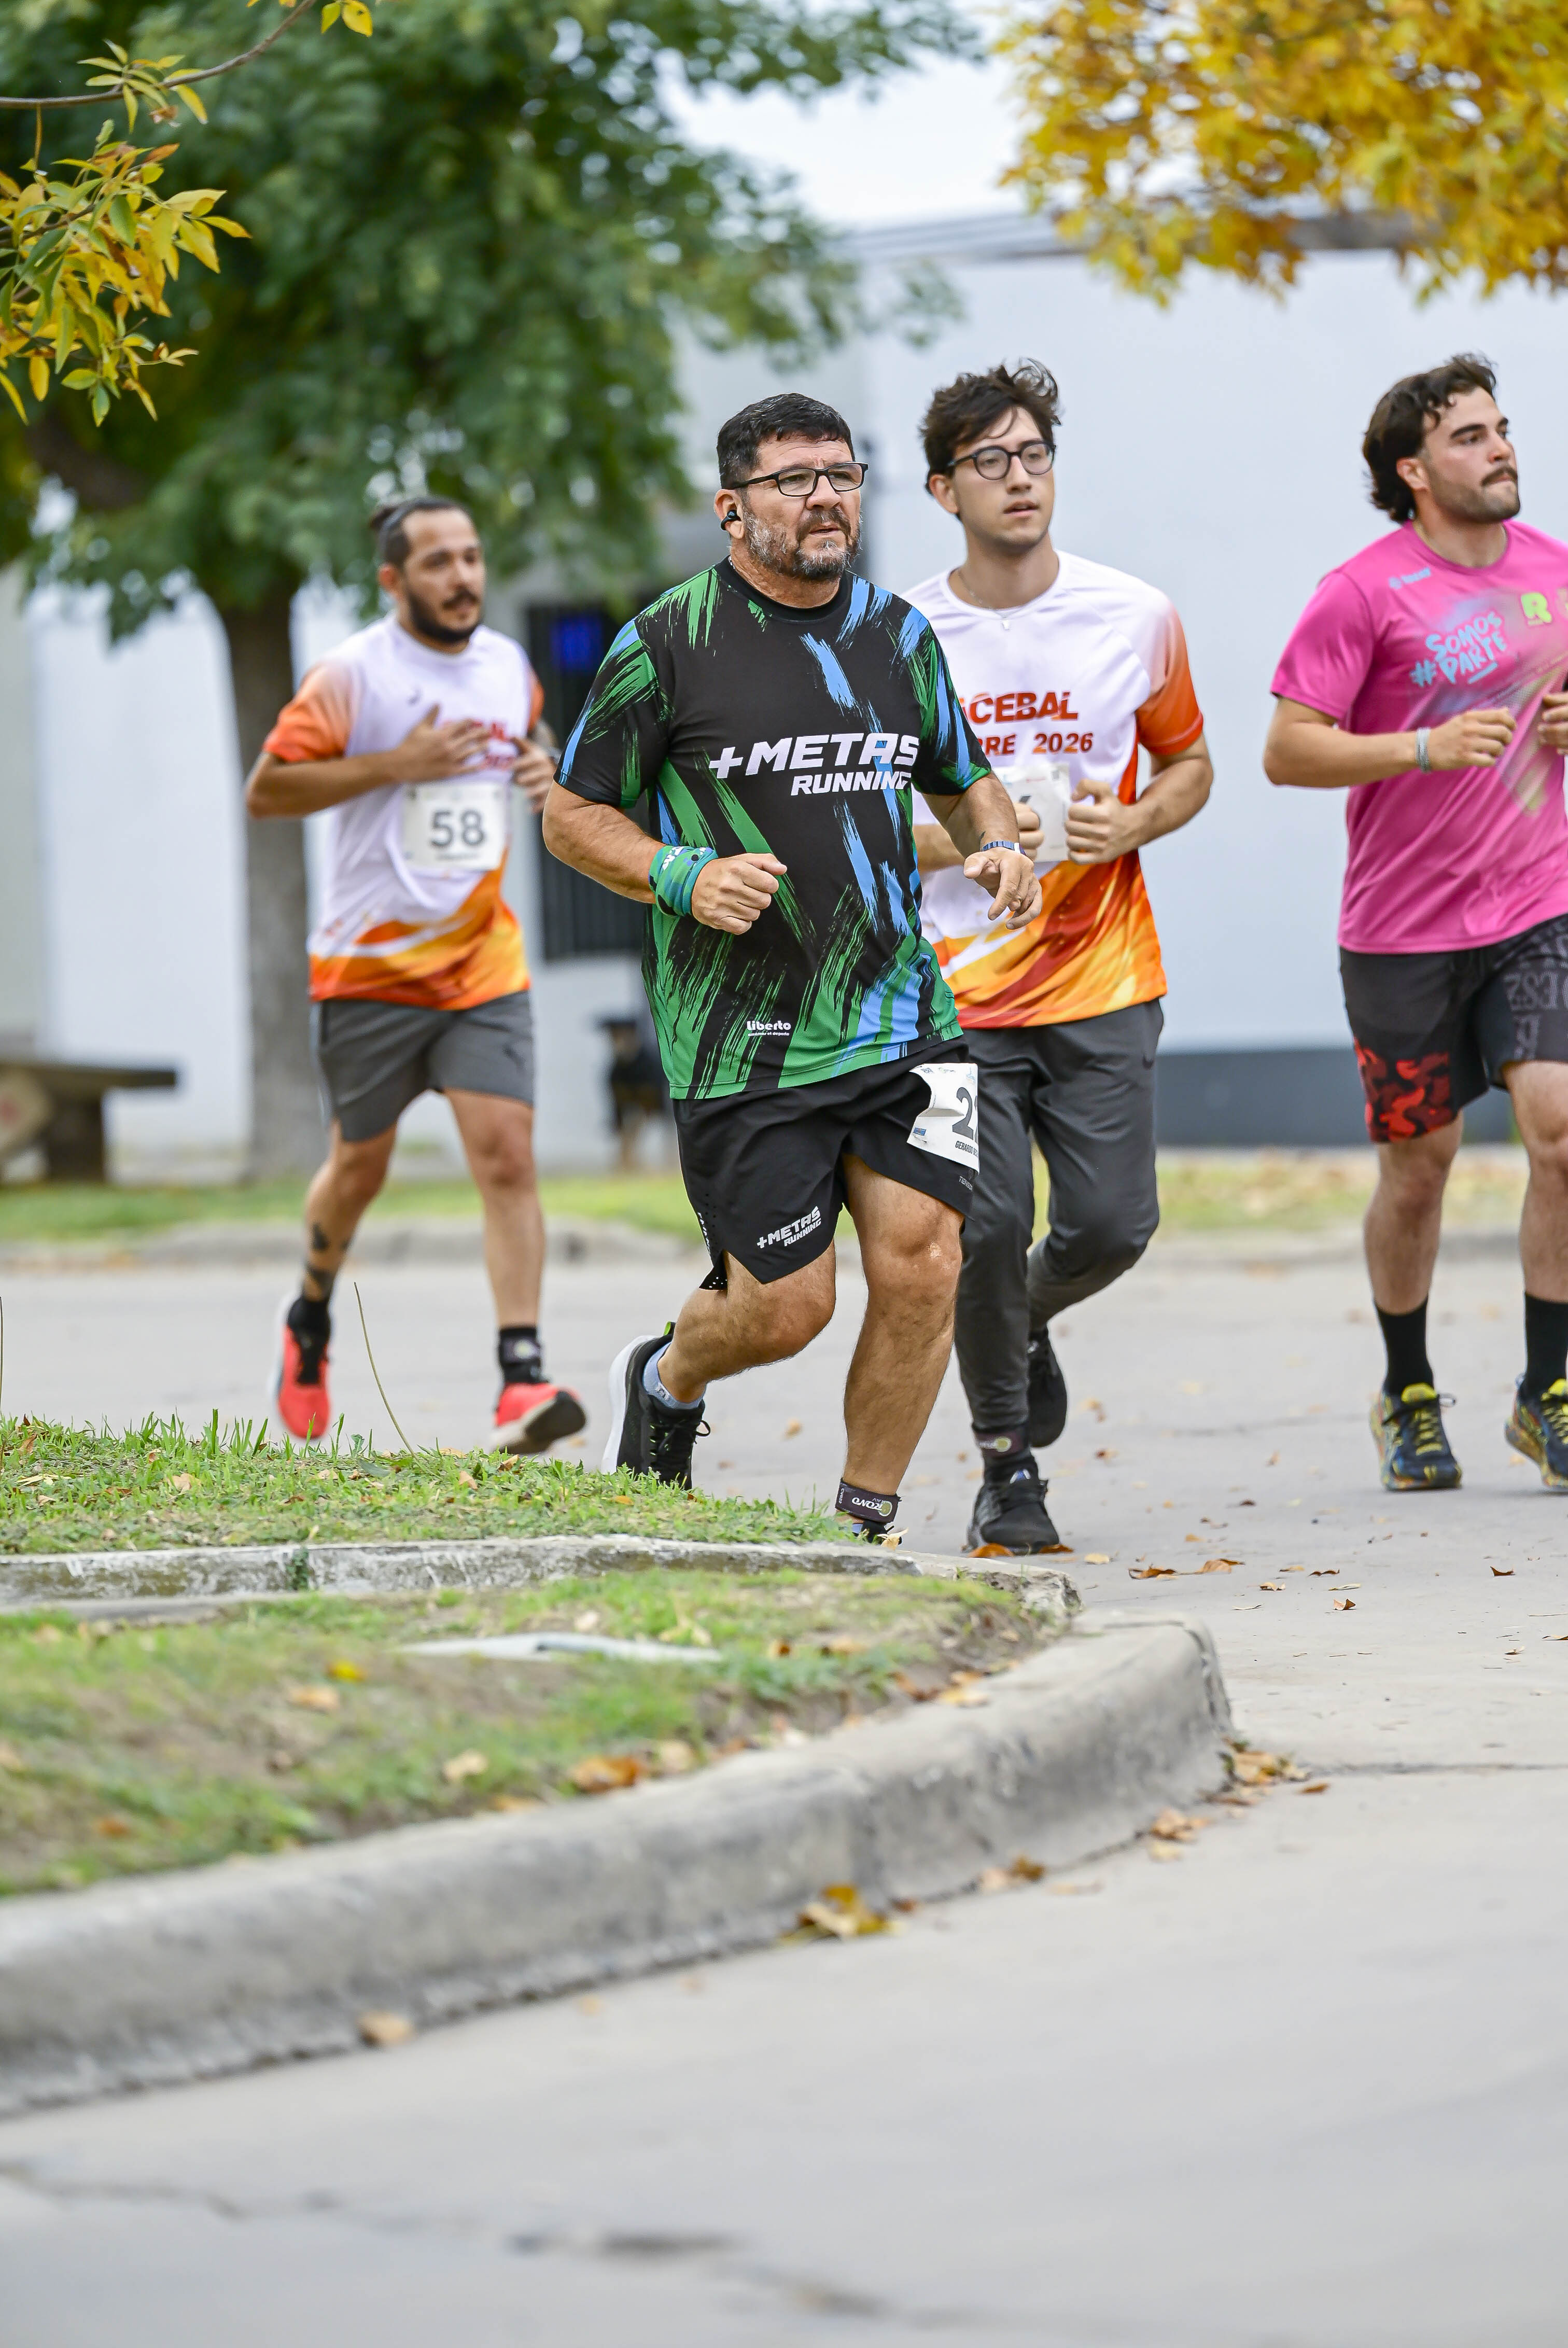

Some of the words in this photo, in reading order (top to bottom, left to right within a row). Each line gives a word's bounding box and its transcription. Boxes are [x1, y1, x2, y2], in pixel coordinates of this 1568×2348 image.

[1425, 611, 1502, 663] SOMOS
[1409, 631, 1506, 688] #PARTE
[959, 691, 1078, 724] CEBAL
[978, 733, 1016, 756] RE
[1033, 732, 1094, 754] 2026
[791, 771, 912, 796] RUNNING
[430, 810, 486, 848] 58
[747, 1020, 791, 1030] liberto
[784, 1218, 821, 1247] RUNNING
